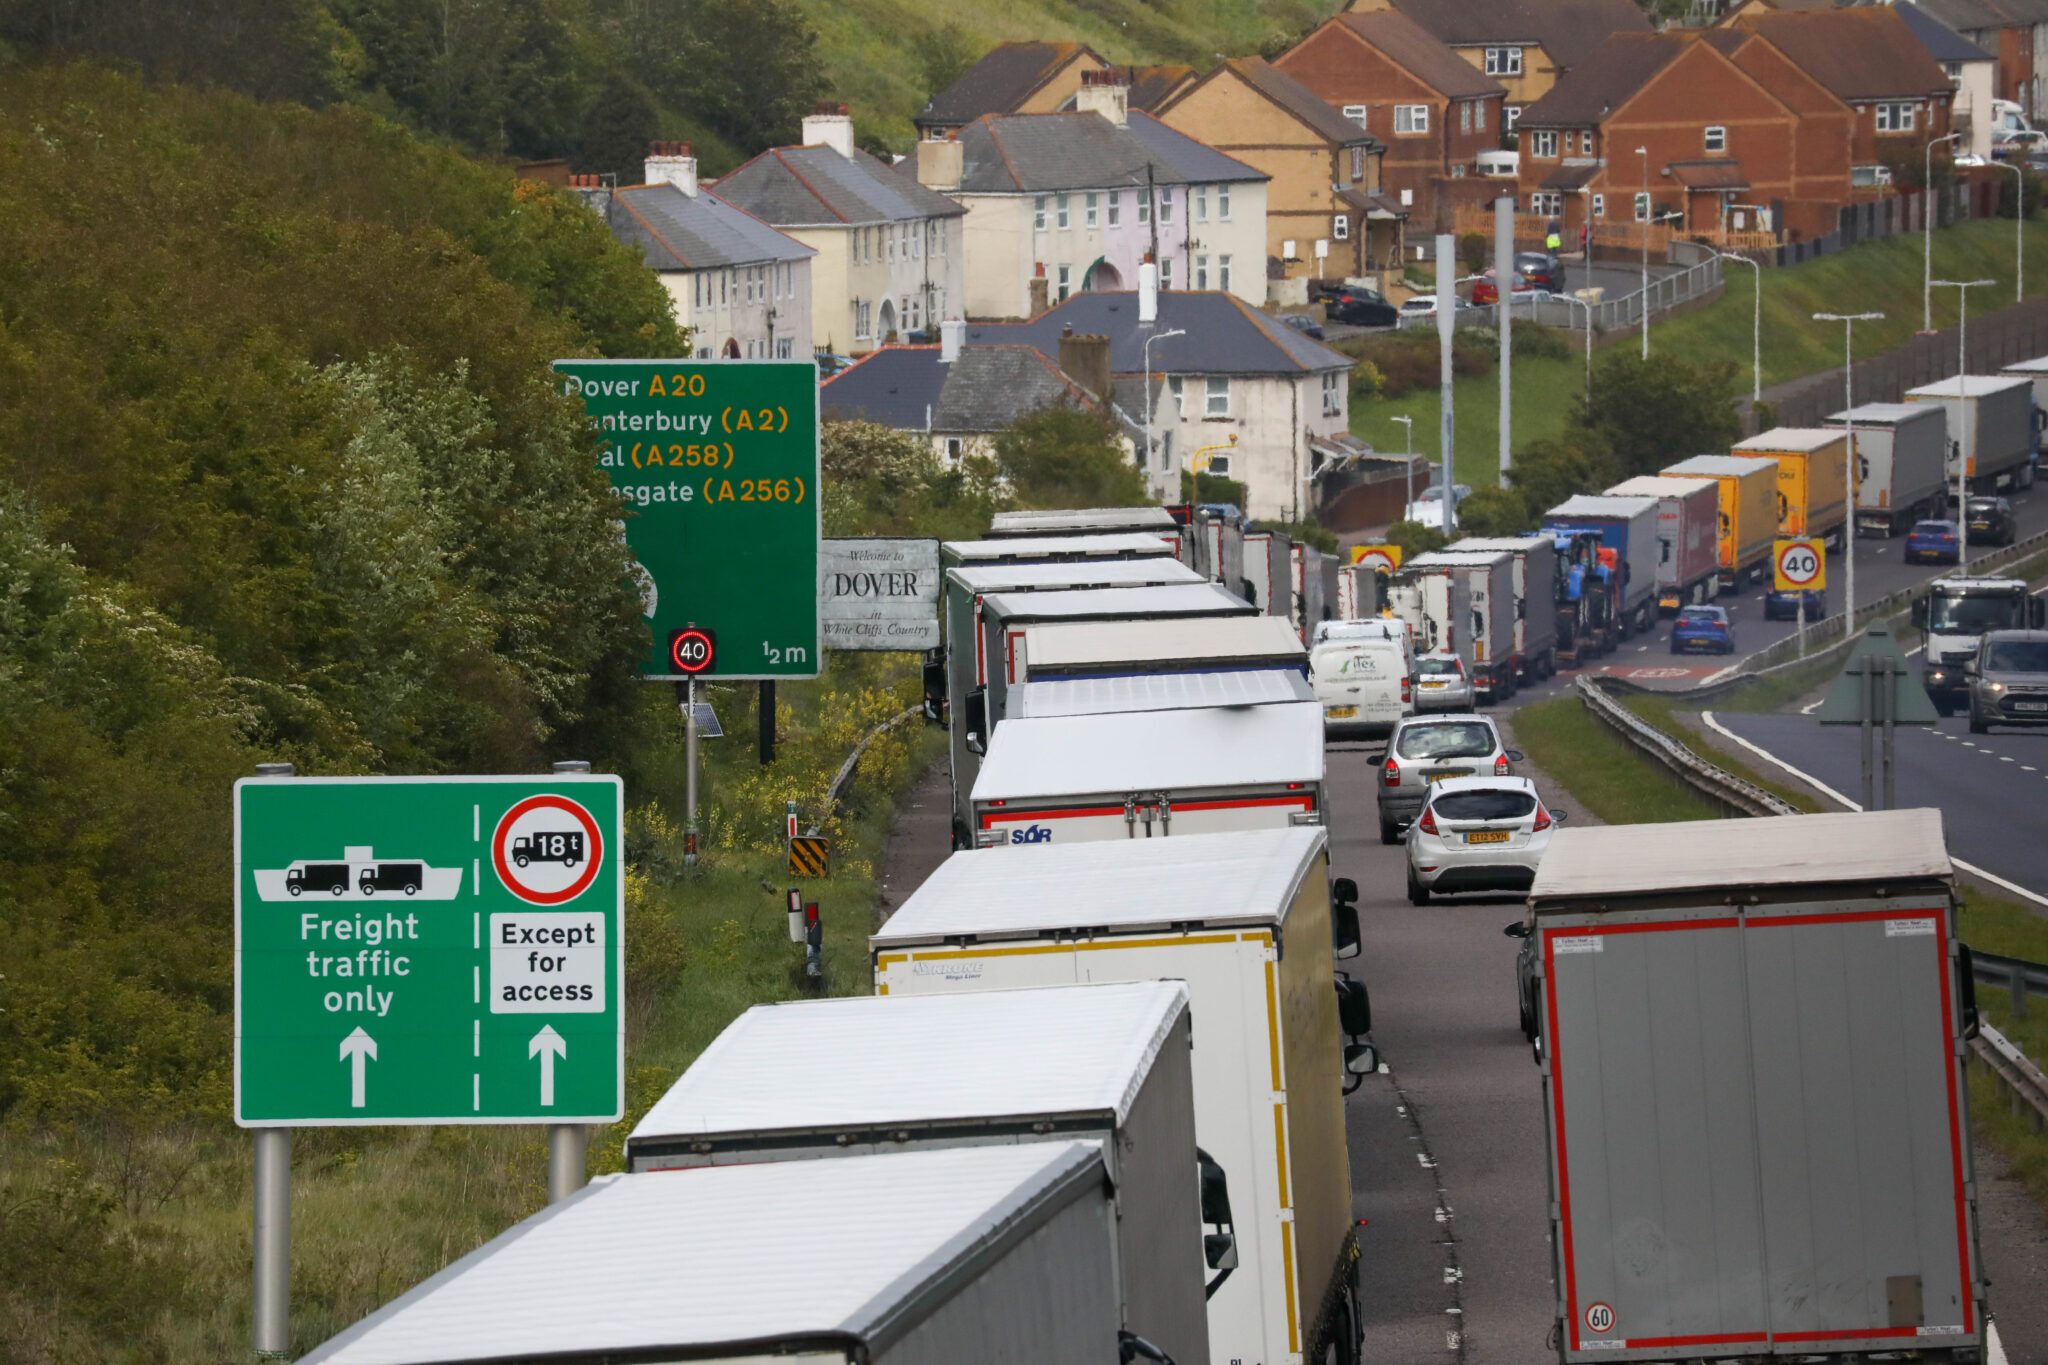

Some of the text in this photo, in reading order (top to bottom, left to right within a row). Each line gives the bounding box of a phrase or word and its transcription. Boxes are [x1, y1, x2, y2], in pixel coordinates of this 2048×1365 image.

[565, 374, 705, 397] Dover A20
[588, 406, 788, 435] nterbury (A2)
[596, 442, 734, 469] al (A258)
[703, 477, 805, 504] (A256)
[850, 550, 905, 561] Welcome to
[1786, 556, 1815, 573] 40
[835, 572, 918, 597] DOVER
[823, 623, 929, 638] White Cliffs Country
[680, 642, 705, 660] 40
[785, 646, 806, 663] m
[301, 912, 419, 946] Freight
[502, 922, 595, 948] Except
[306, 949, 411, 977] traffic
[528, 951, 566, 973] for
[323, 984, 394, 1017] only
[502, 984, 594, 1002] access
[1592, 1308, 1609, 1327] 60
